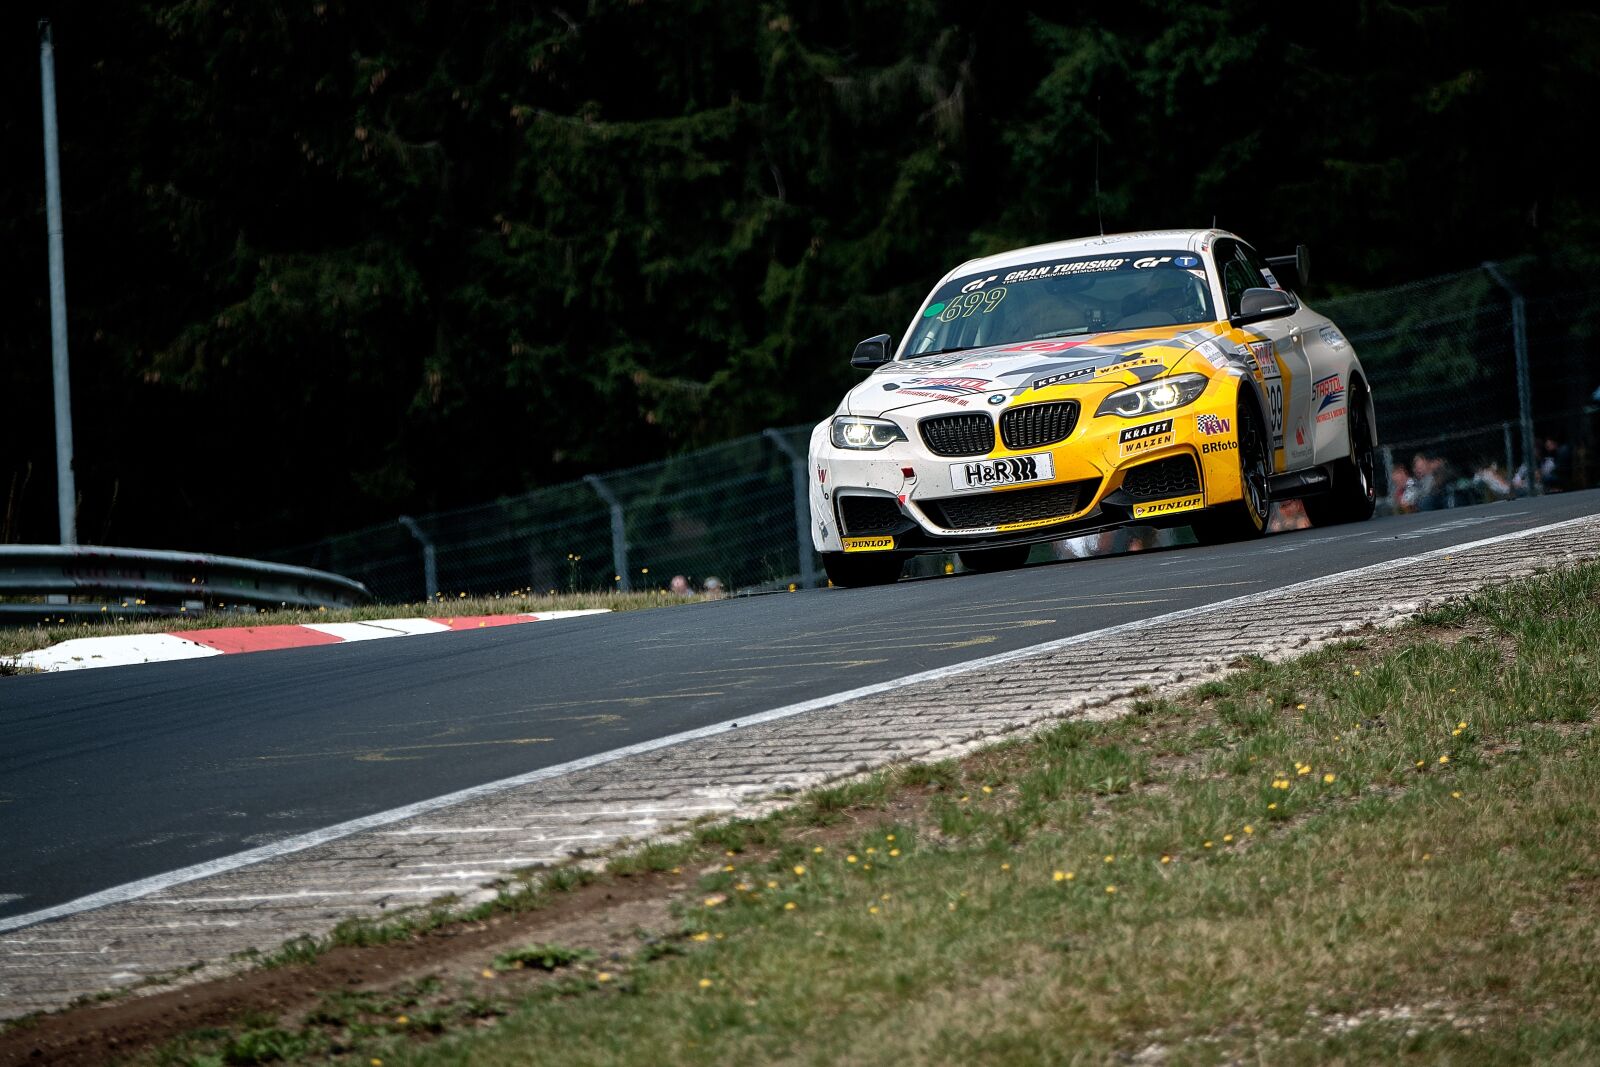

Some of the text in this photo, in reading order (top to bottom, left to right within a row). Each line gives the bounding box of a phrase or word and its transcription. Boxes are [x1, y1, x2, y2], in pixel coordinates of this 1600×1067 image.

[1004, 258, 1123, 281] GRAN TURISMO
[1179, 256, 1193, 266] T
[1039, 269, 1071, 279] DRIVING
[1072, 266, 1117, 276] SIMULATOR
[940, 287, 1007, 322] 699
[1037, 357, 1160, 386] KRAFFT WALZEN
[1124, 422, 1169, 440] KRAFFT
[1204, 418, 1232, 437] KW
[1125, 434, 1173, 452] WALZEN
[1201, 440, 1239, 455] BRfoto
[1146, 497, 1202, 514] DUNLOP
[851, 540, 892, 549] DUNLOP
